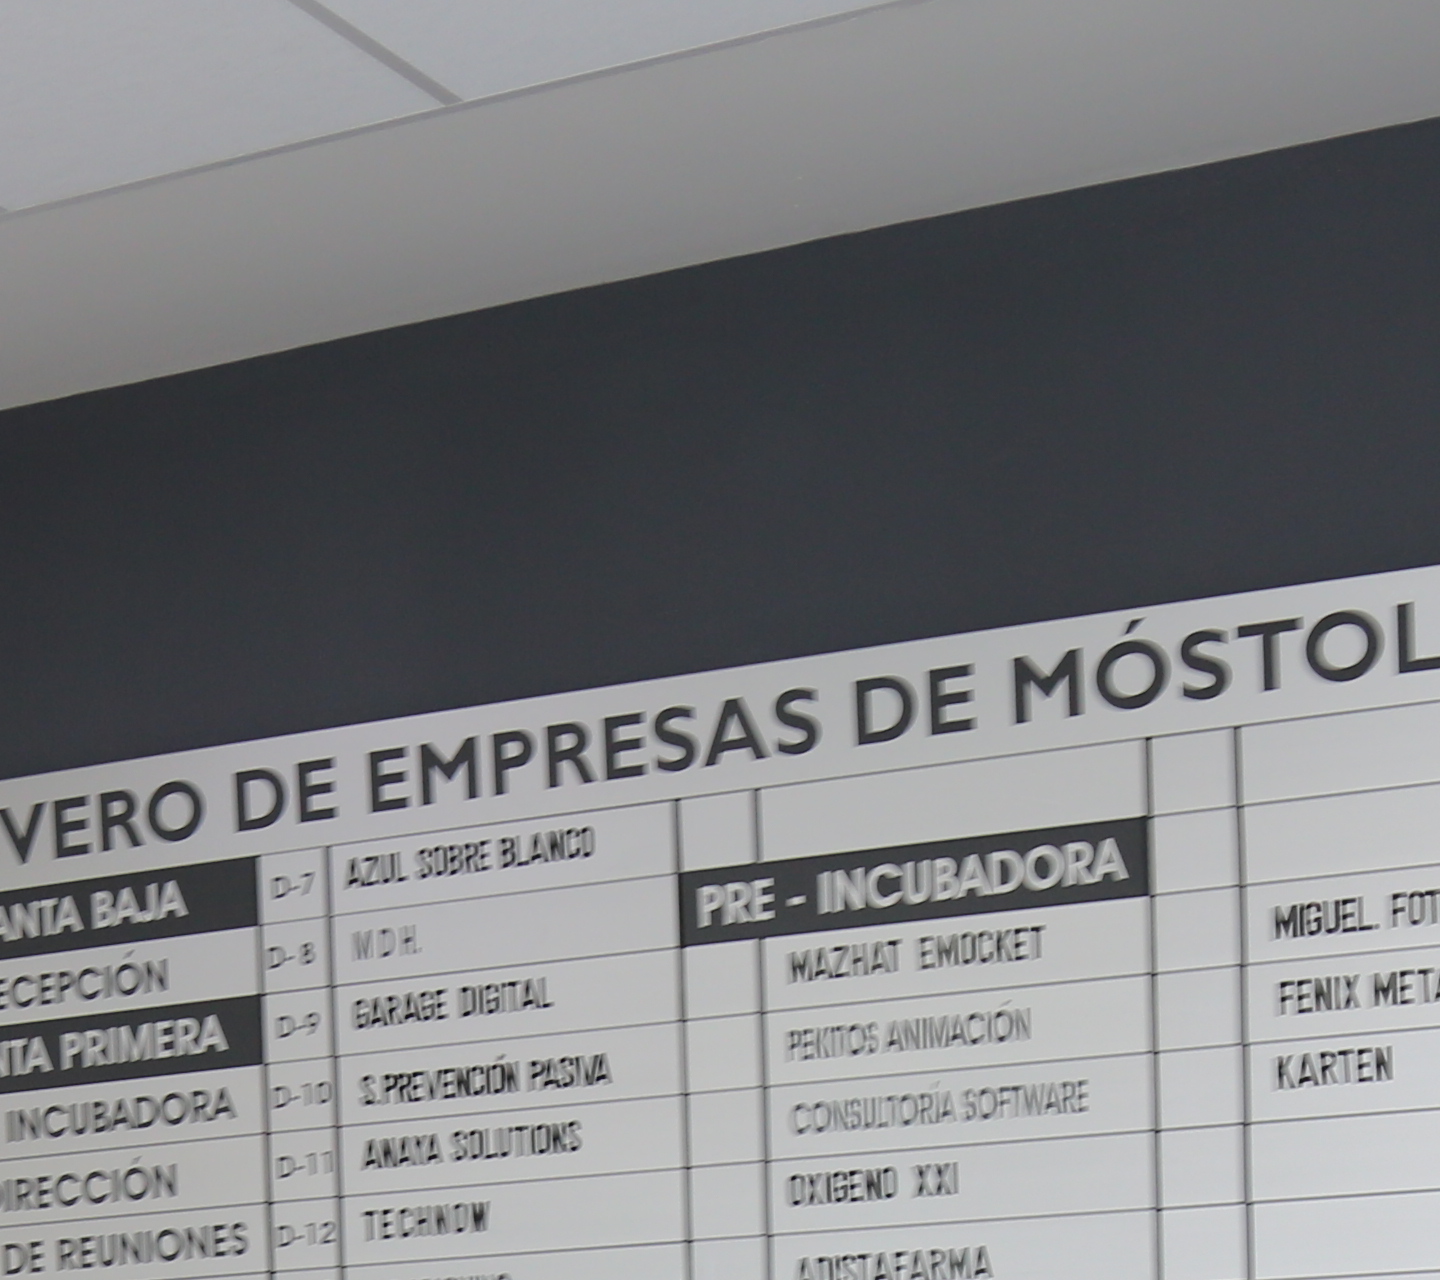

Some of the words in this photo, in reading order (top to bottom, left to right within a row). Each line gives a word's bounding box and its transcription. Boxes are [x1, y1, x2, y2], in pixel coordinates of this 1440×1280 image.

[232, 756, 338, 832] DE
[367, 686, 821, 815] EMPRESAS
[855, 663, 978, 746] DE
[345, 852, 409, 890] AZUL
[417, 839, 493, 880] SOBRE
[498, 826, 596, 870] BLANCO
[696, 877, 776, 928] PRE
[817, 837, 1130, 916] INCUBADORA
[91, 878, 188, 930] BAJA
[271, 871, 317, 900] D-7
[786, 938, 903, 984] MAZHAT
[917, 925, 1047, 970] EMOCKET
[352, 988, 449, 1030] GARAGE
[457, 977, 555, 1018] DIGITAL
[1276, 973, 1362, 1016] FENIX
[59, 1014, 229, 1071] PRIMERA
[785, 1021, 879, 1062] PEKITOS
[885, 999, 1032, 1053] ANIMACIÓN
[527, 1052, 613, 1091] PASIVA
[1273, 1045, 1394, 1091] KARTEN
[6, 1086, 238, 1143] INCUBADORA
[790, 1080, 957, 1136] CONSULTORÍA
[961, 1079, 1090, 1122] SOFTWARE
[361, 1133, 445, 1171] ANAYA
[449, 1120, 583, 1163] SOLUTIONS
[787, 1166, 898, 1206] OXIGENO
[911, 1162, 959, 1199] XXI
[362, 1201, 491, 1241] TECHNOW
[1, 1240, 46, 1275] DE
[55, 1221, 250, 1271] REUNIONES
